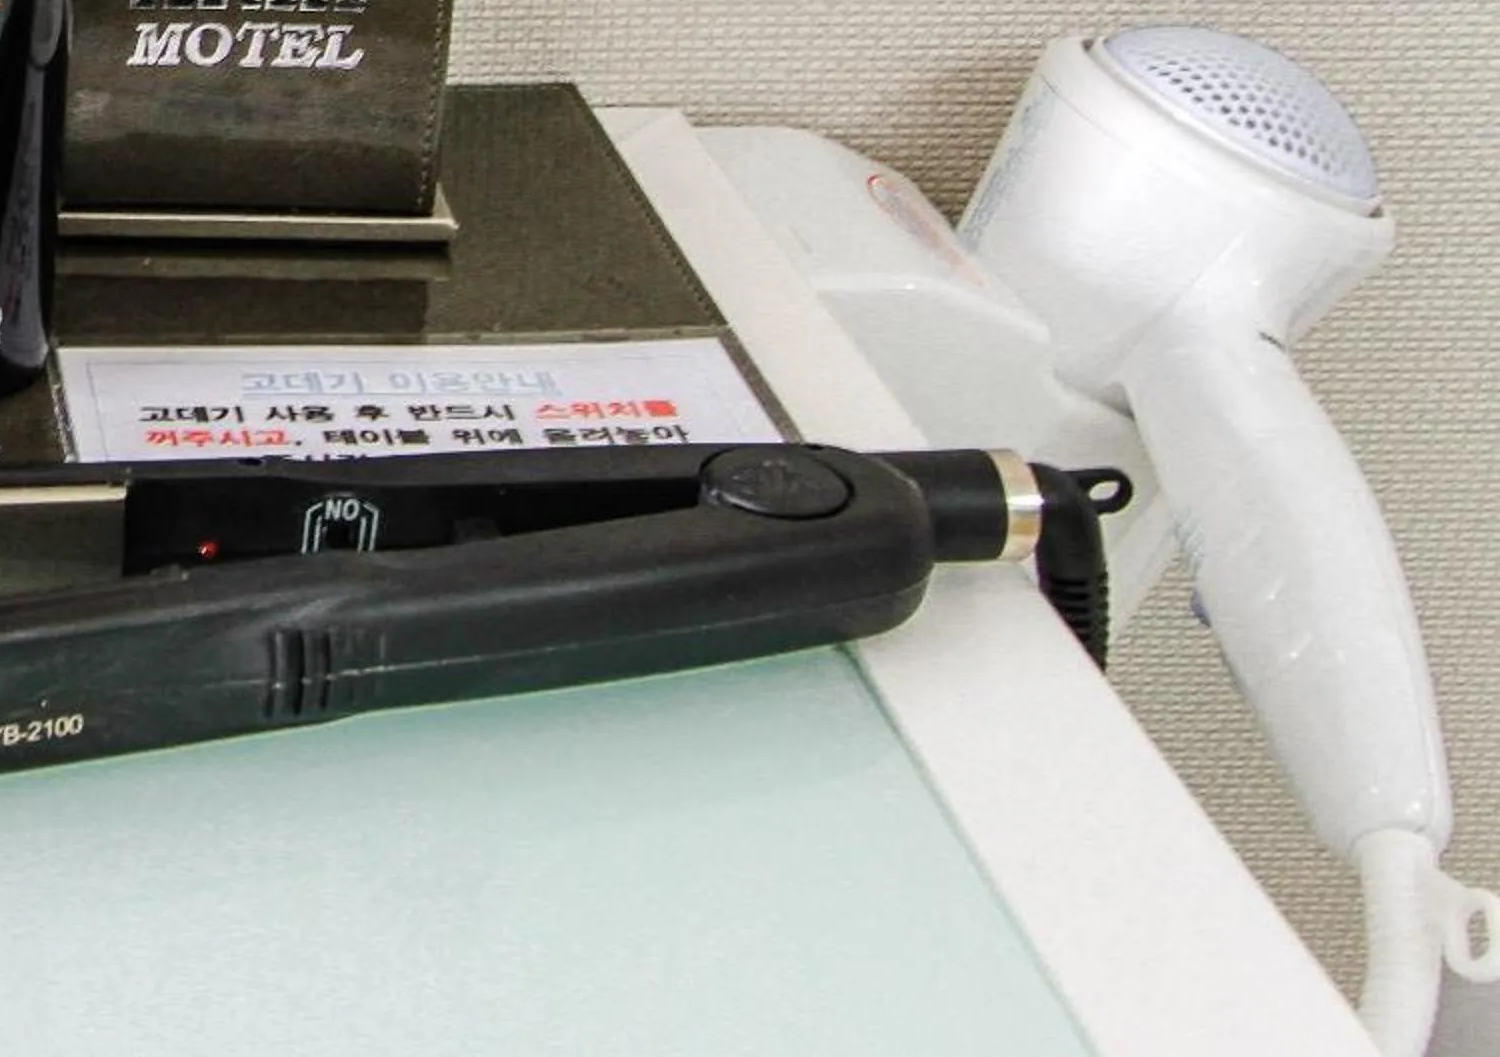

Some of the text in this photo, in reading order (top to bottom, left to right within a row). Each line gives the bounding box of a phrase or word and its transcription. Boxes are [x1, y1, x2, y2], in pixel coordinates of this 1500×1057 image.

[126, 21, 366, 70] MOTEL
[242, 371, 364, 393] 고대기
[139, 400, 677, 423] 고대기 사용 후 반드시 스위치를
[323, 428, 430, 446] 테이블
[452, 427, 523, 445] 위에
